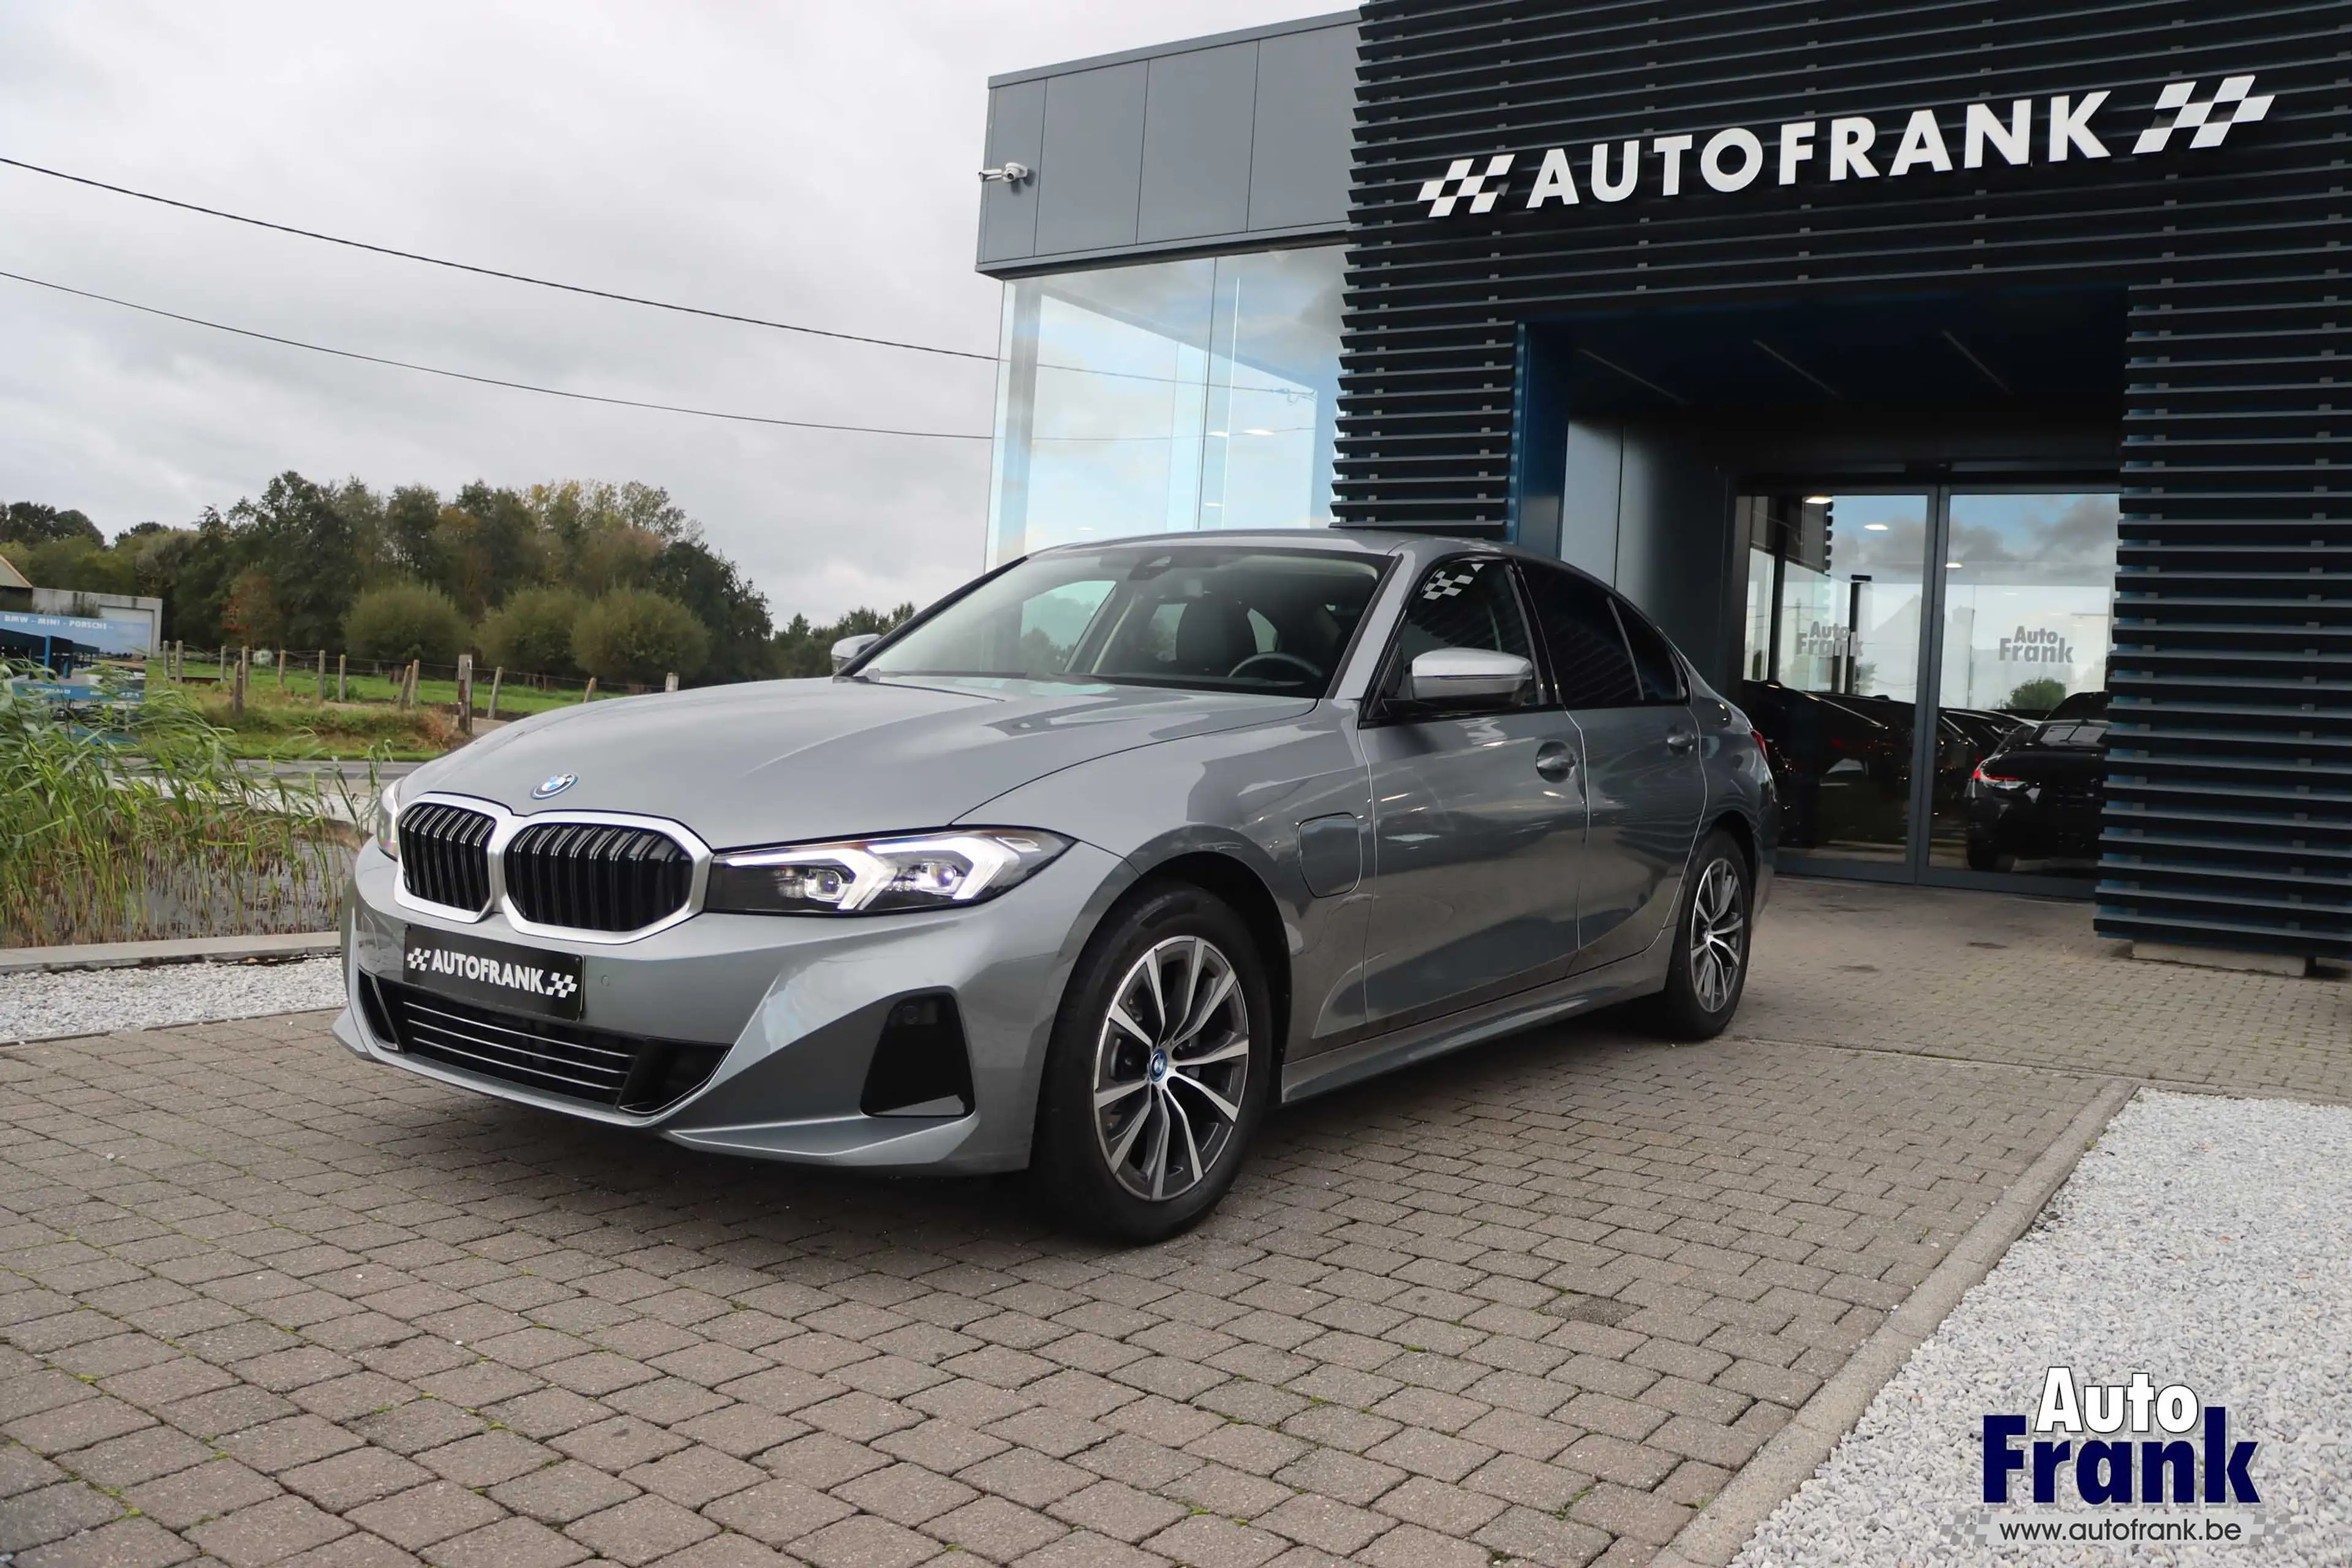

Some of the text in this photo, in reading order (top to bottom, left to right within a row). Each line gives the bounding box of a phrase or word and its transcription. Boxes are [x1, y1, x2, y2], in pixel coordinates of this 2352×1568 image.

[1526, 91, 2112, 209] AUTOFRANK
[4, 614, 28, 624] BMW
[37, 617, 60, 626] MINI
[69, 620, 107, 630] PORSCHE
[1809, 621, 1850, 638] Auto
[1796, 631, 1863, 656] Frank
[2014, 626, 2058, 644] Auto
[1999, 638, 2073, 663] Frank
[431, 949, 544, 994] AUTOFRANK
